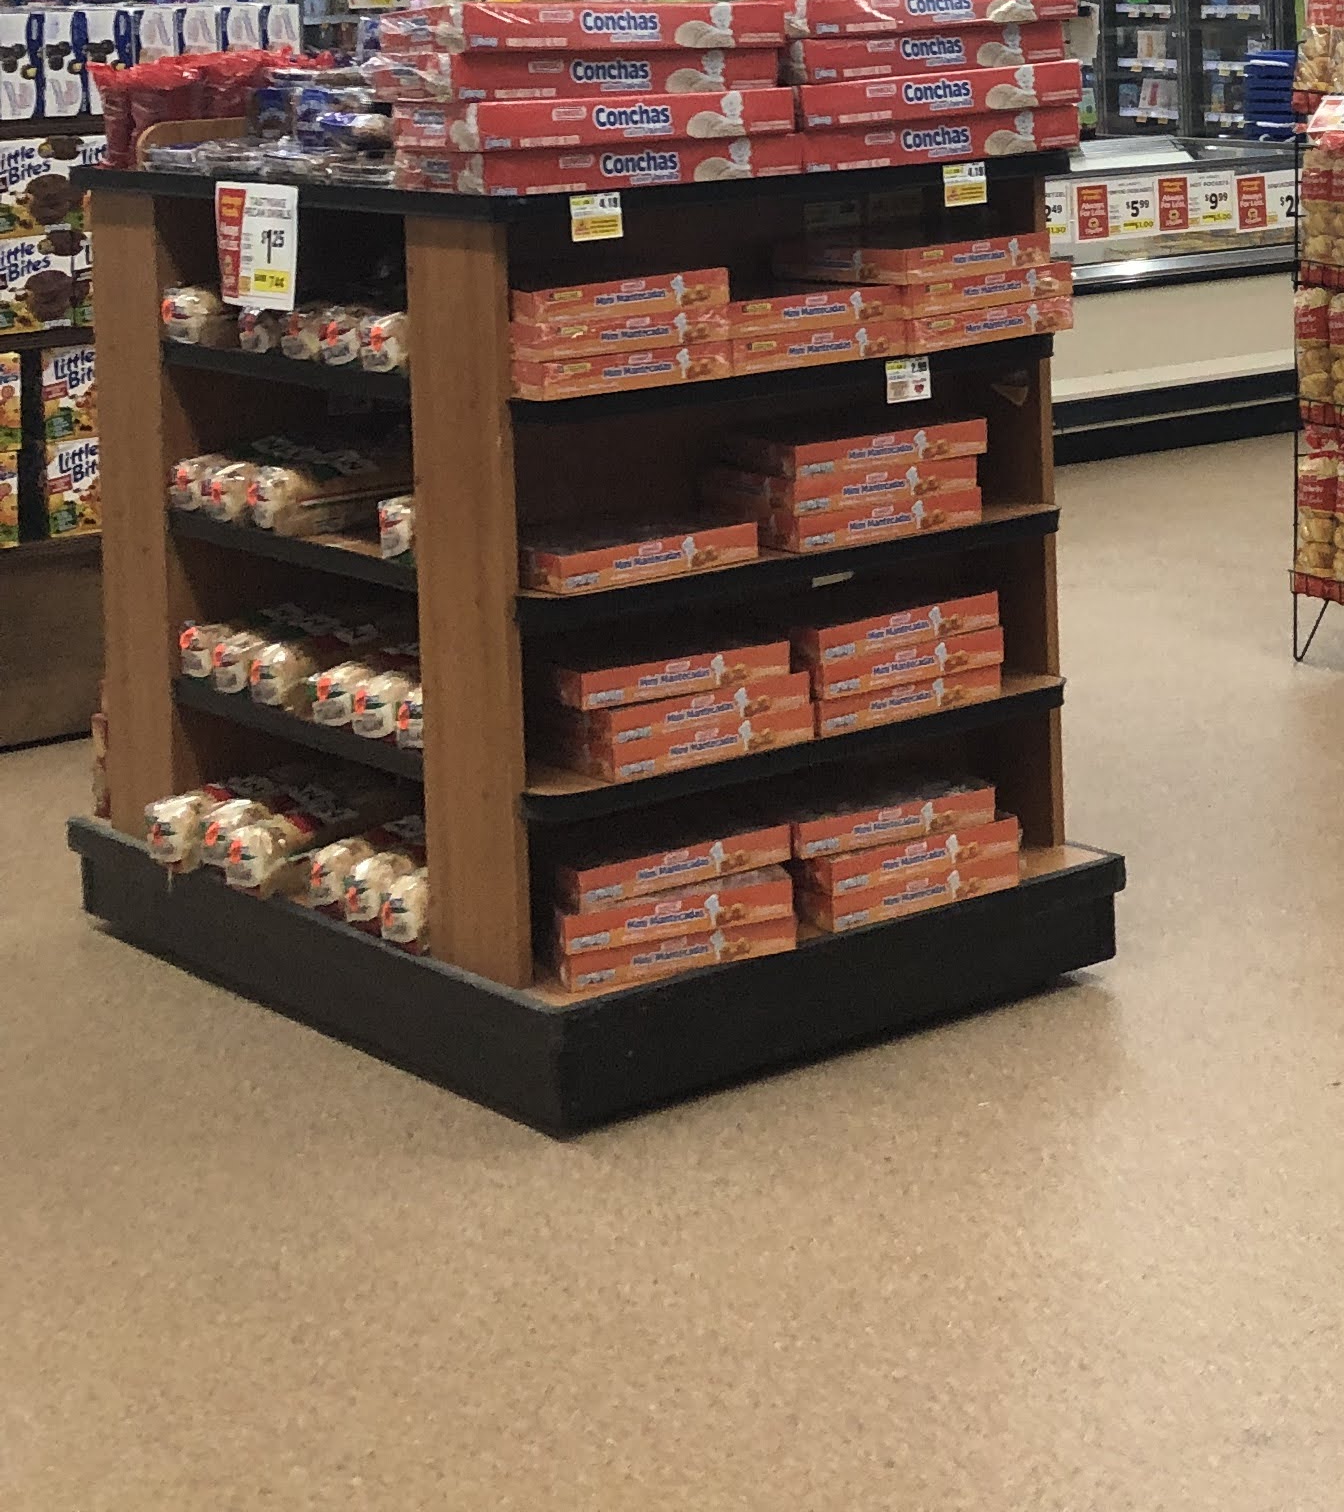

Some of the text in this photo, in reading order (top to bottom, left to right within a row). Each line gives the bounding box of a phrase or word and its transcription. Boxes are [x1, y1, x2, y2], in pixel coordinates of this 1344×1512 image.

[582, 10, 659, 32] Conchas
[902, 37, 963, 58] Conchas
[573, 59, 650, 82] Conchas
[903, 80, 971, 103] Conchas
[594, 104, 671, 128] Conchas
[903, 126, 970, 150] Conchas
[0, 146, 35, 174] ittle
[9, 159, 51, 185] Bites
[602, 152, 679, 176] Conchas
[0, 242, 35, 270] ittle
[9, 256, 51, 282] Bites
[54, 349, 95, 381] Little
[68, 367, 95, 389] Bit
[59, 443, 98, 474] Little
[72, 458, 98, 483] Bit
